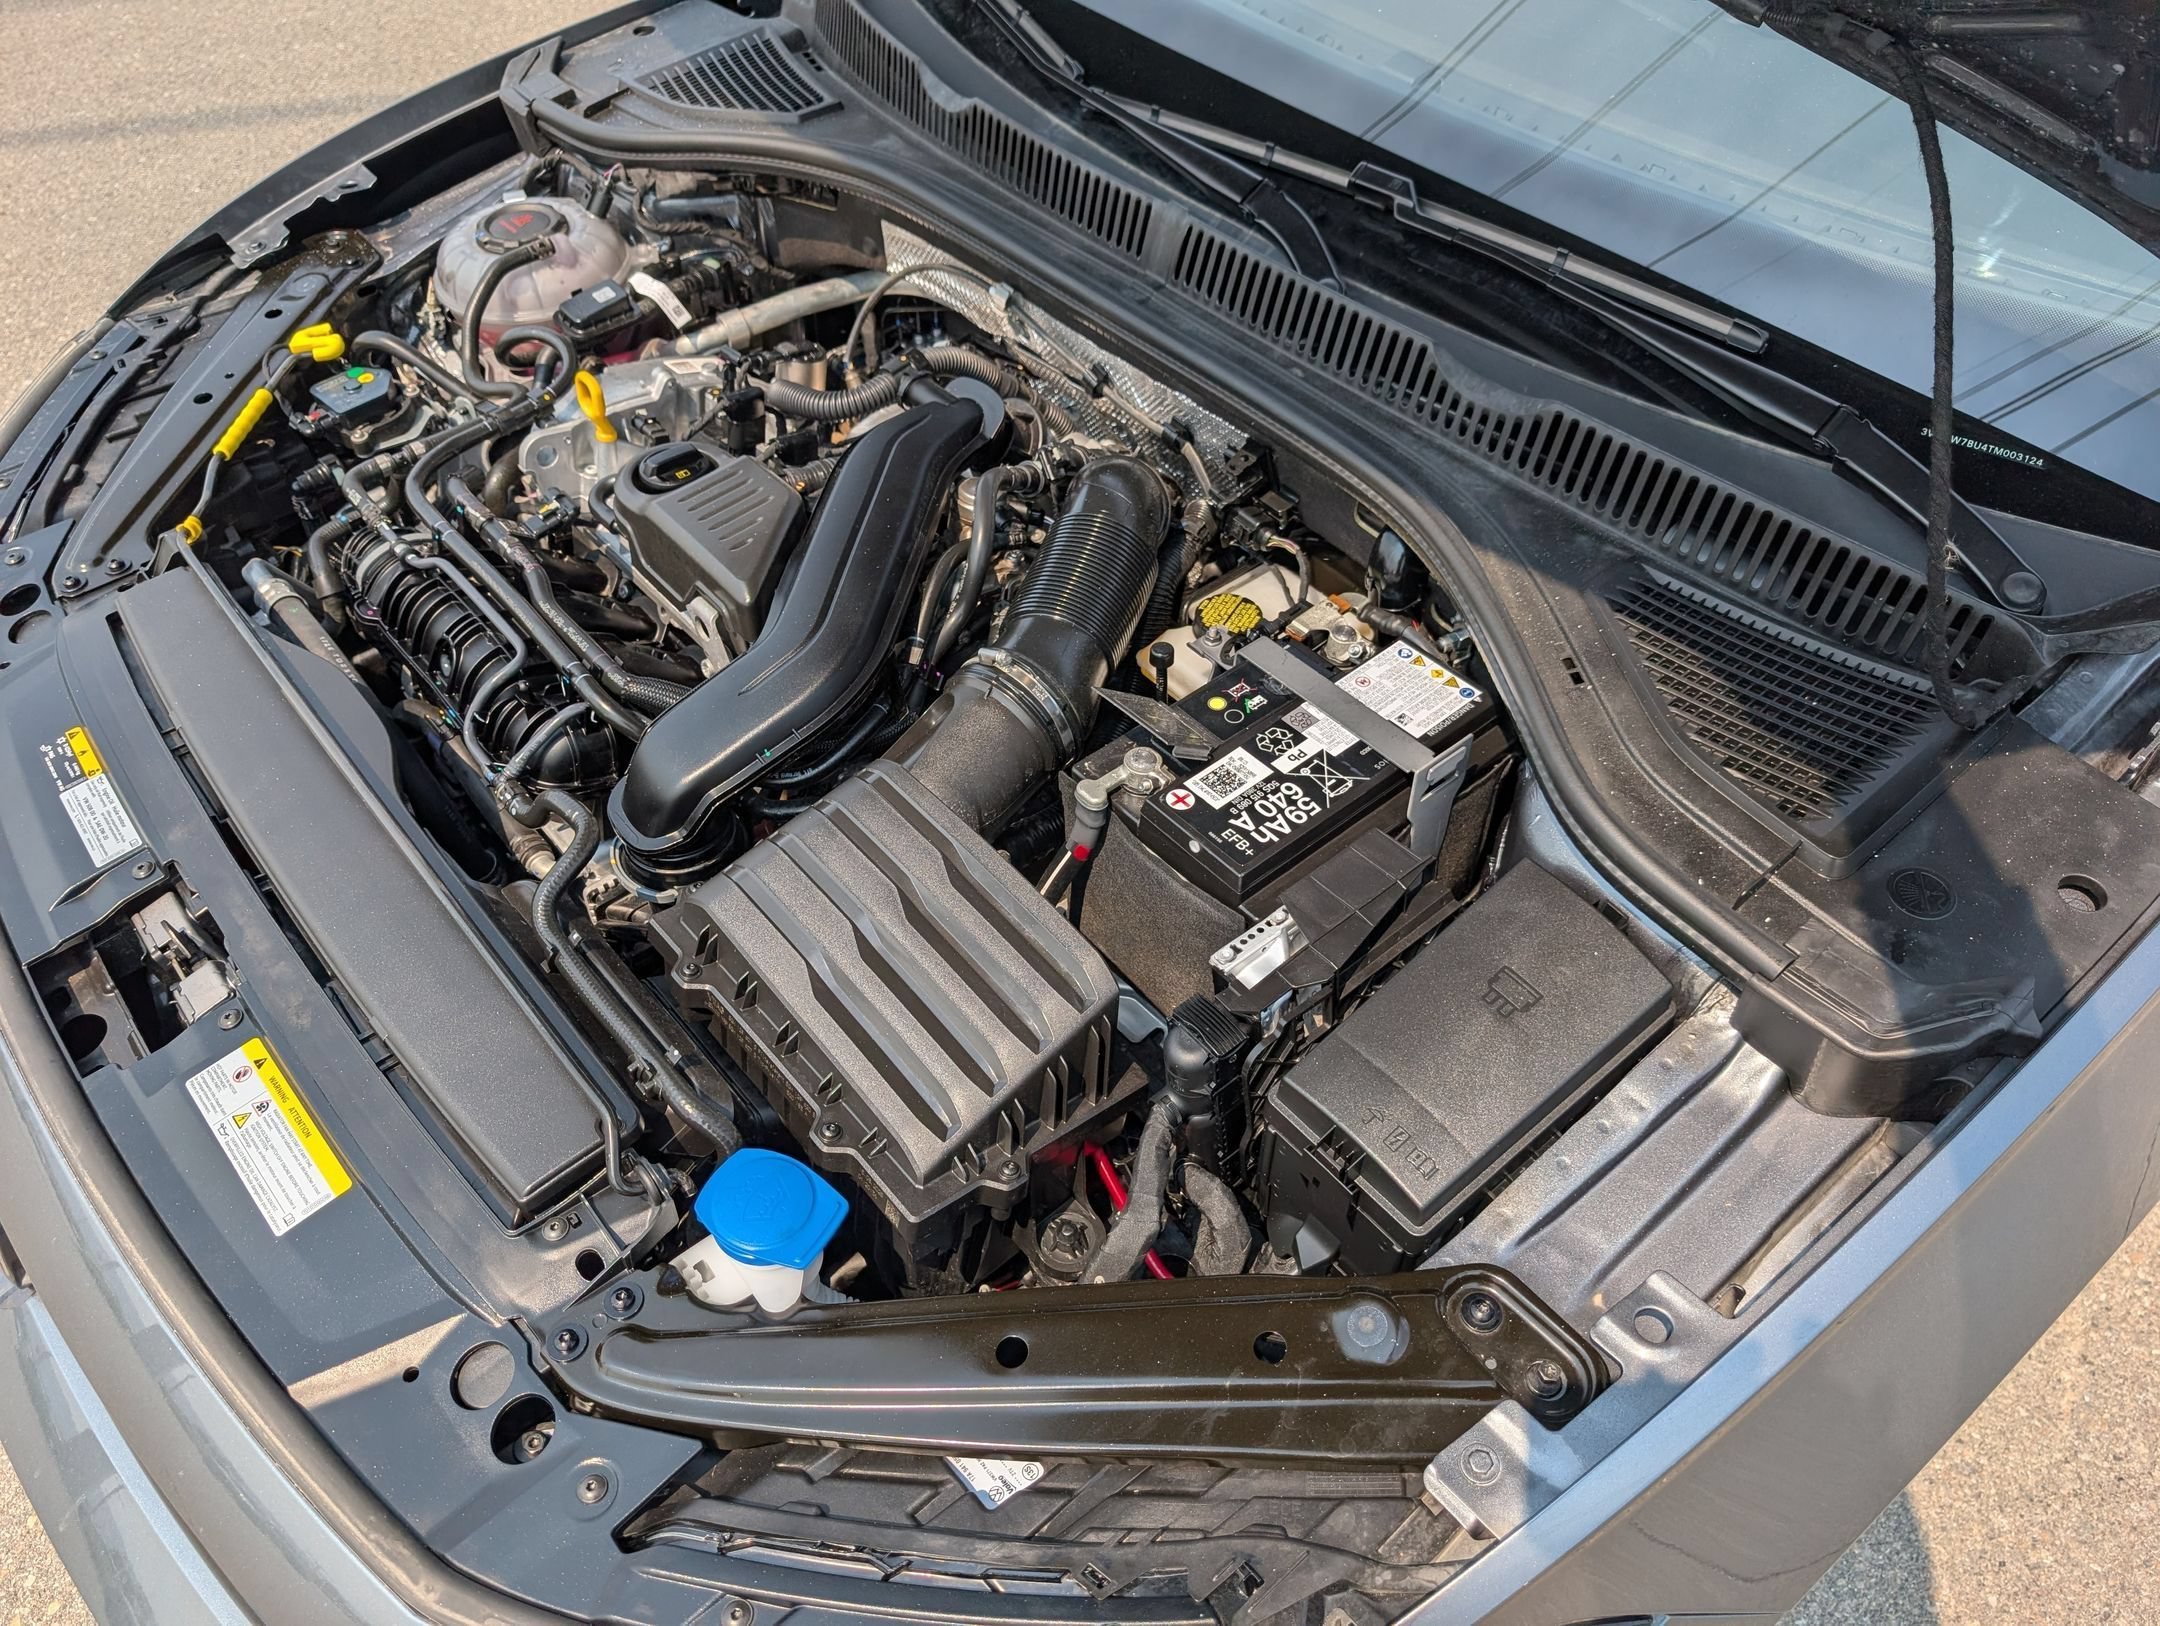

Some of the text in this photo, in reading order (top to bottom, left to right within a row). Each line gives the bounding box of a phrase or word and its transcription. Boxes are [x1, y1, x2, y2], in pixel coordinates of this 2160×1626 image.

[1427, 703, 1476, 737] DANGER/POISON
[1287, 748, 1307, 763] Pb
[1250, 790, 1264, 800] 915
[1253, 781, 1303, 816] 640
[1228, 811, 1259, 833] A
[1249, 796, 1322, 844] 59Ah
[1221, 828, 1254, 857] EFB+
[269, 1076, 311, 1137] WARNING ATTENTION
[998, 1475, 1014, 1494] Valeo
[1024, 1466, 1036, 1478] 13S
